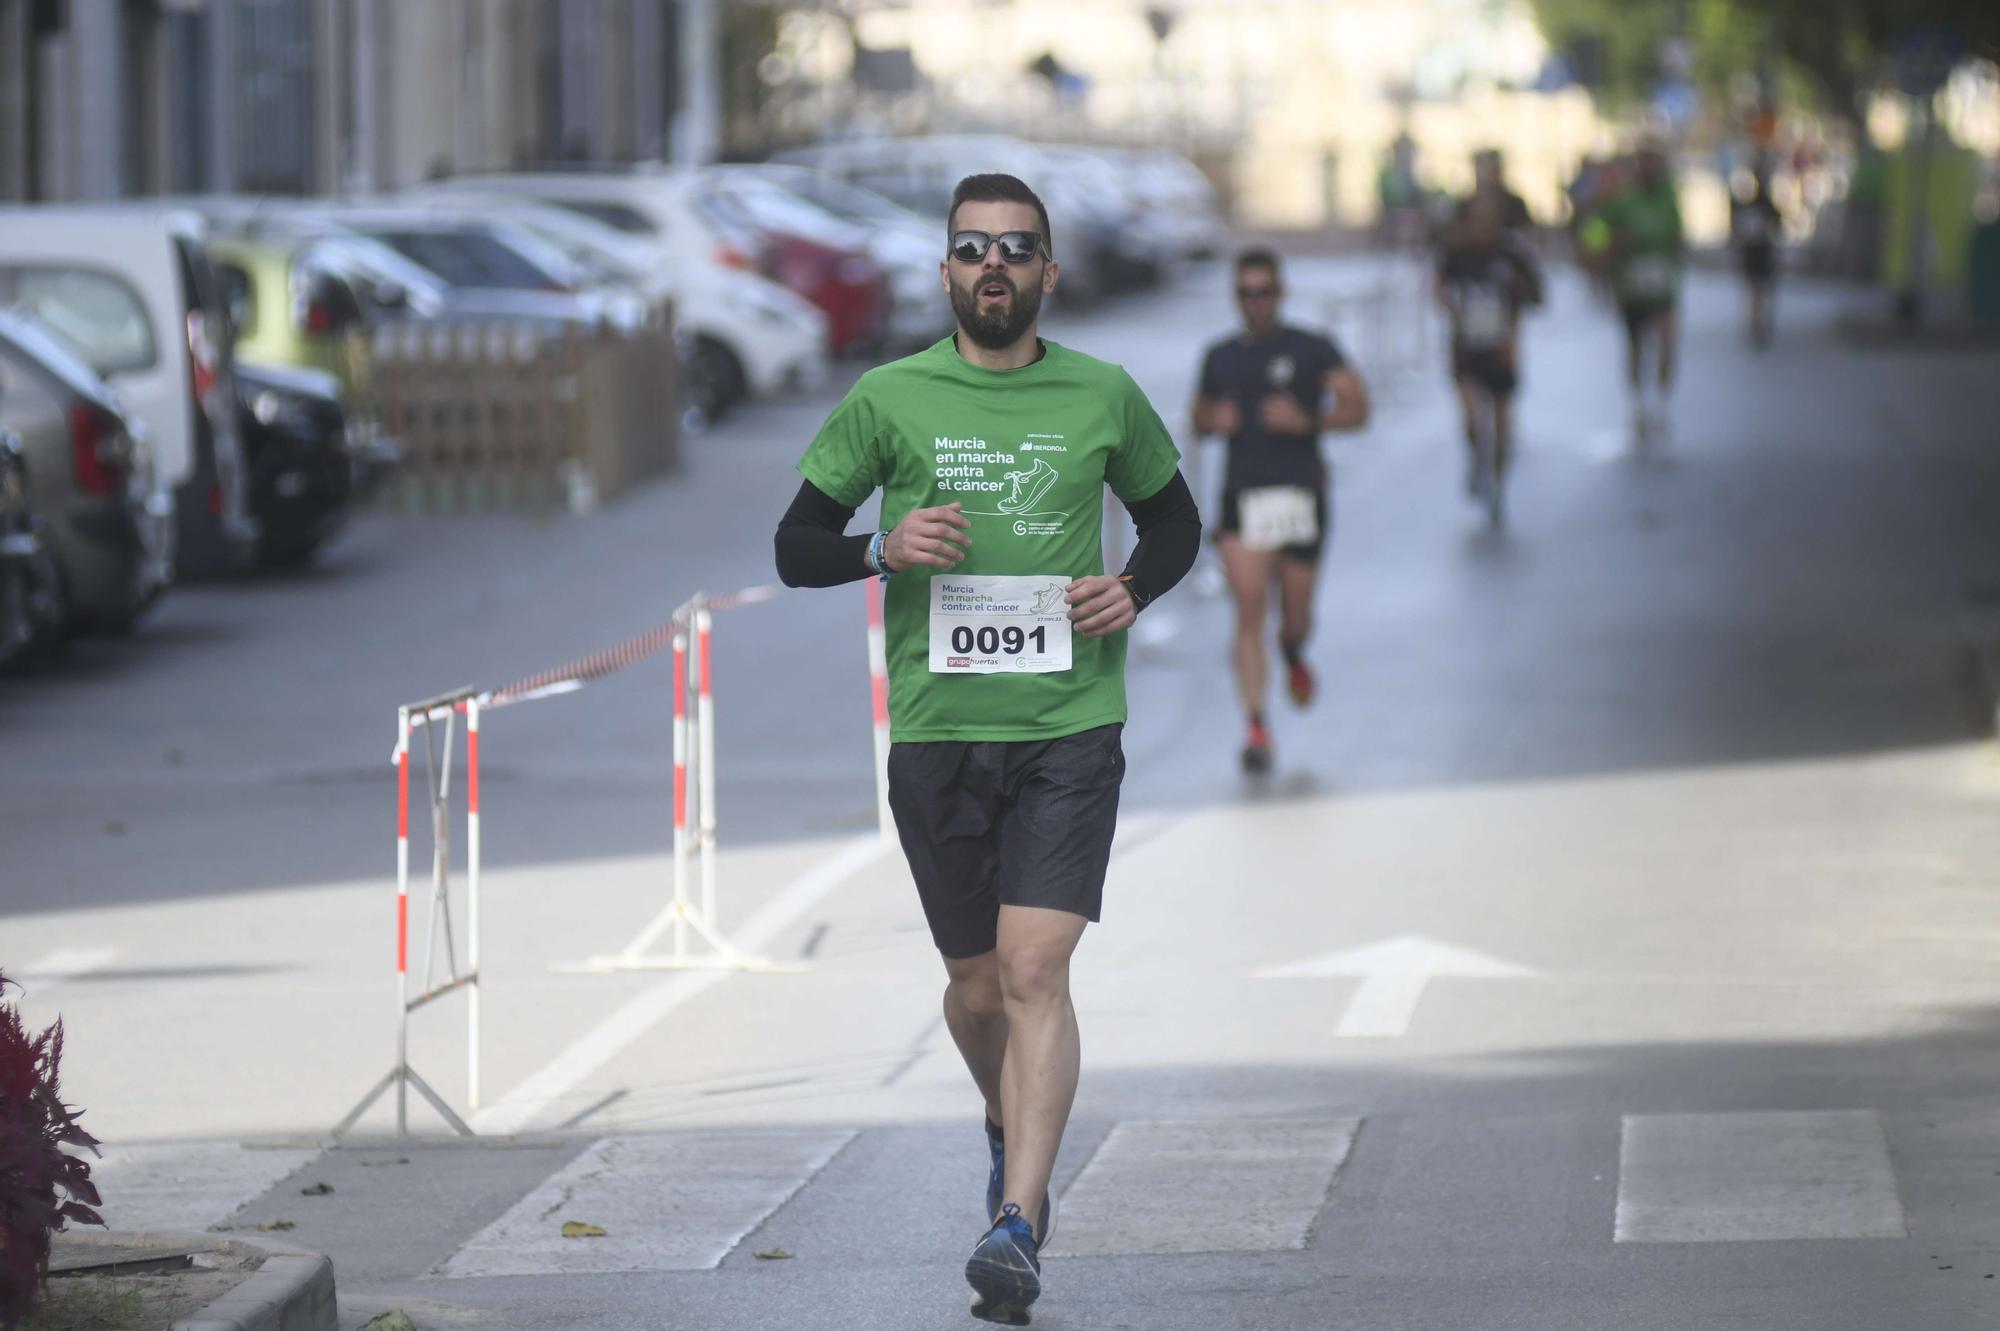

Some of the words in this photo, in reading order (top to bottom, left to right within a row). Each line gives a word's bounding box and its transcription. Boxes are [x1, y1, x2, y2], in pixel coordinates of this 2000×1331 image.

[935, 437, 986, 449] Murcia
[936, 454, 953, 463] en
[958, 451, 1014, 464] marcha
[936, 465, 984, 477] contra
[938, 479, 951, 490] el
[954, 479, 1005, 491] cáncer
[942, 584, 974, 593] Murcia
[956, 594, 993, 602] marcha
[942, 603, 972, 611] contra
[975, 603, 984, 611] el
[952, 626, 1045, 654] 0091
